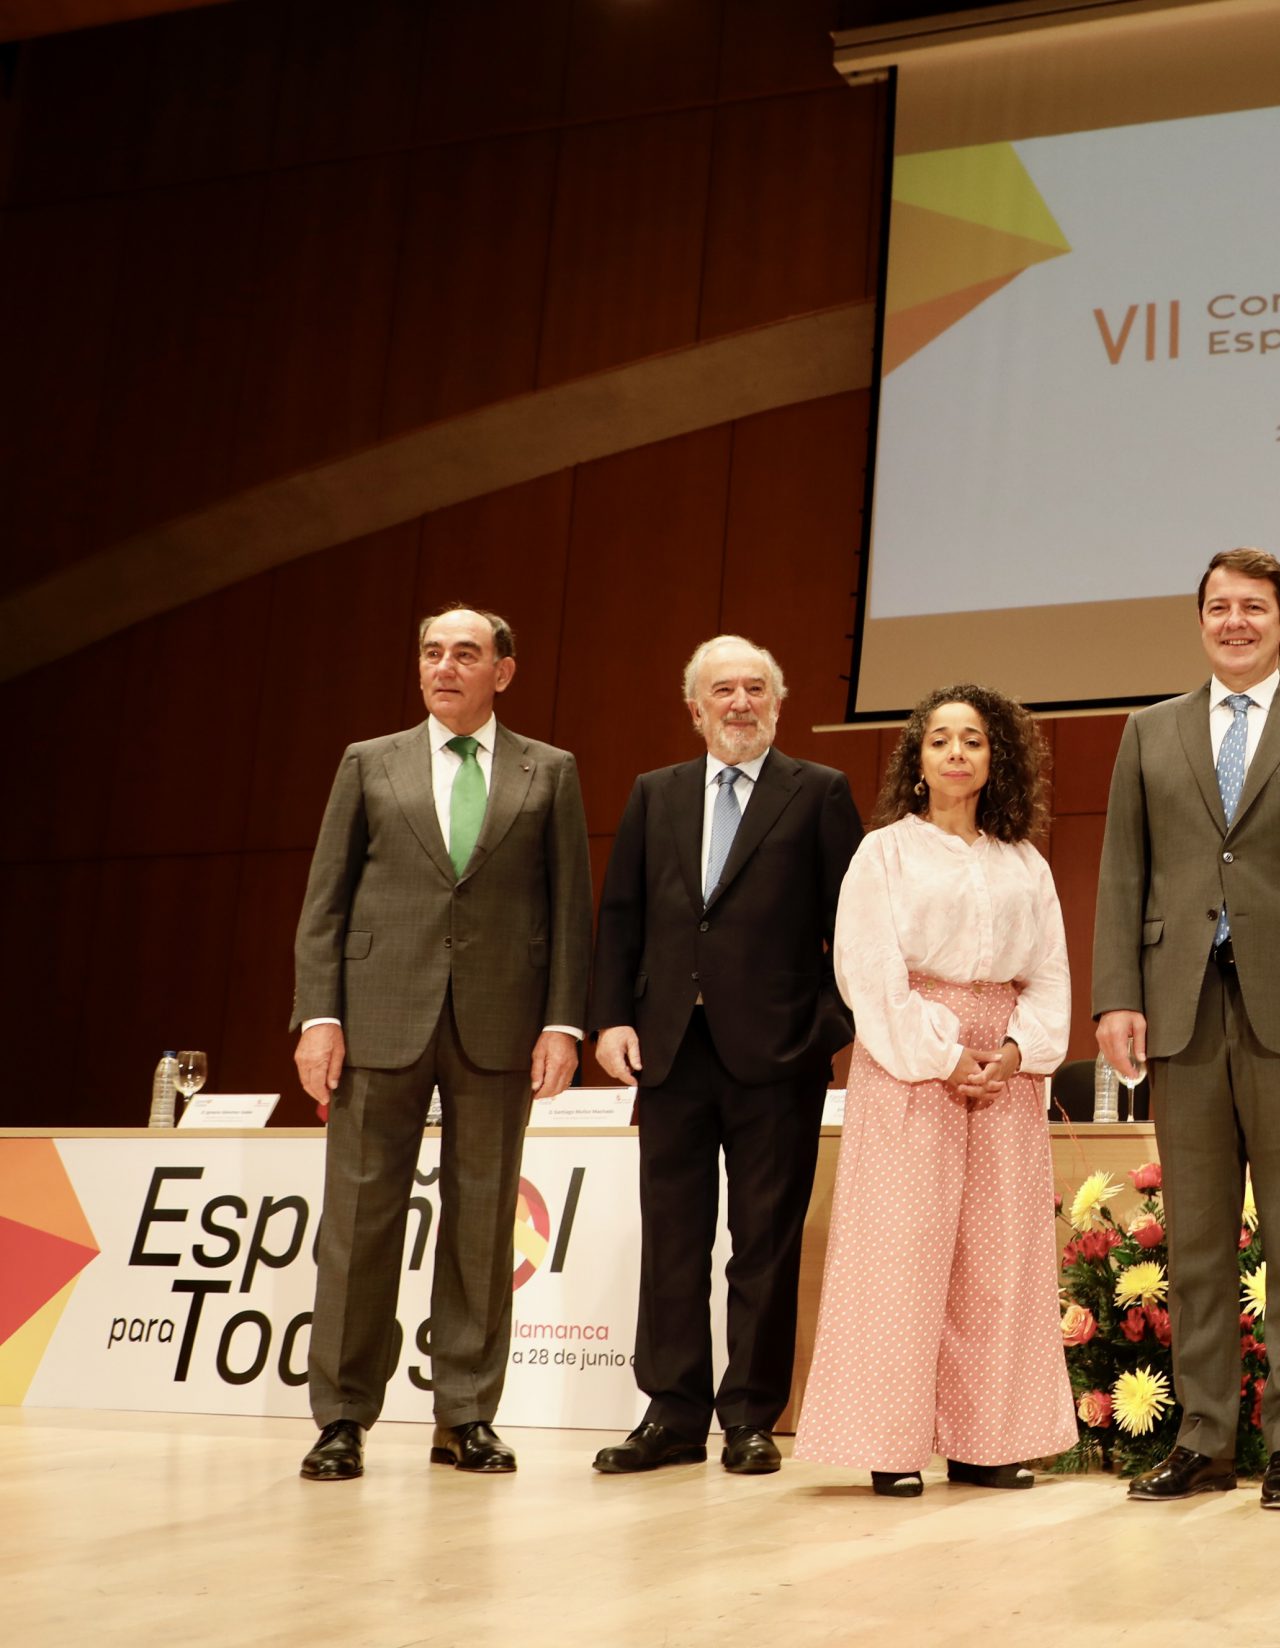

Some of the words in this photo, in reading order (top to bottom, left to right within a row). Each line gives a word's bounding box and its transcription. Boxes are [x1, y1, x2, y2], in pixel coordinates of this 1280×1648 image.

[1093, 299, 1180, 366] VII
[107, 1316, 175, 1350] para
[512, 1351, 523, 1364] a
[528, 1348, 549, 1365] 28
[554, 1348, 577, 1365] de
[580, 1348, 626, 1371] junio
